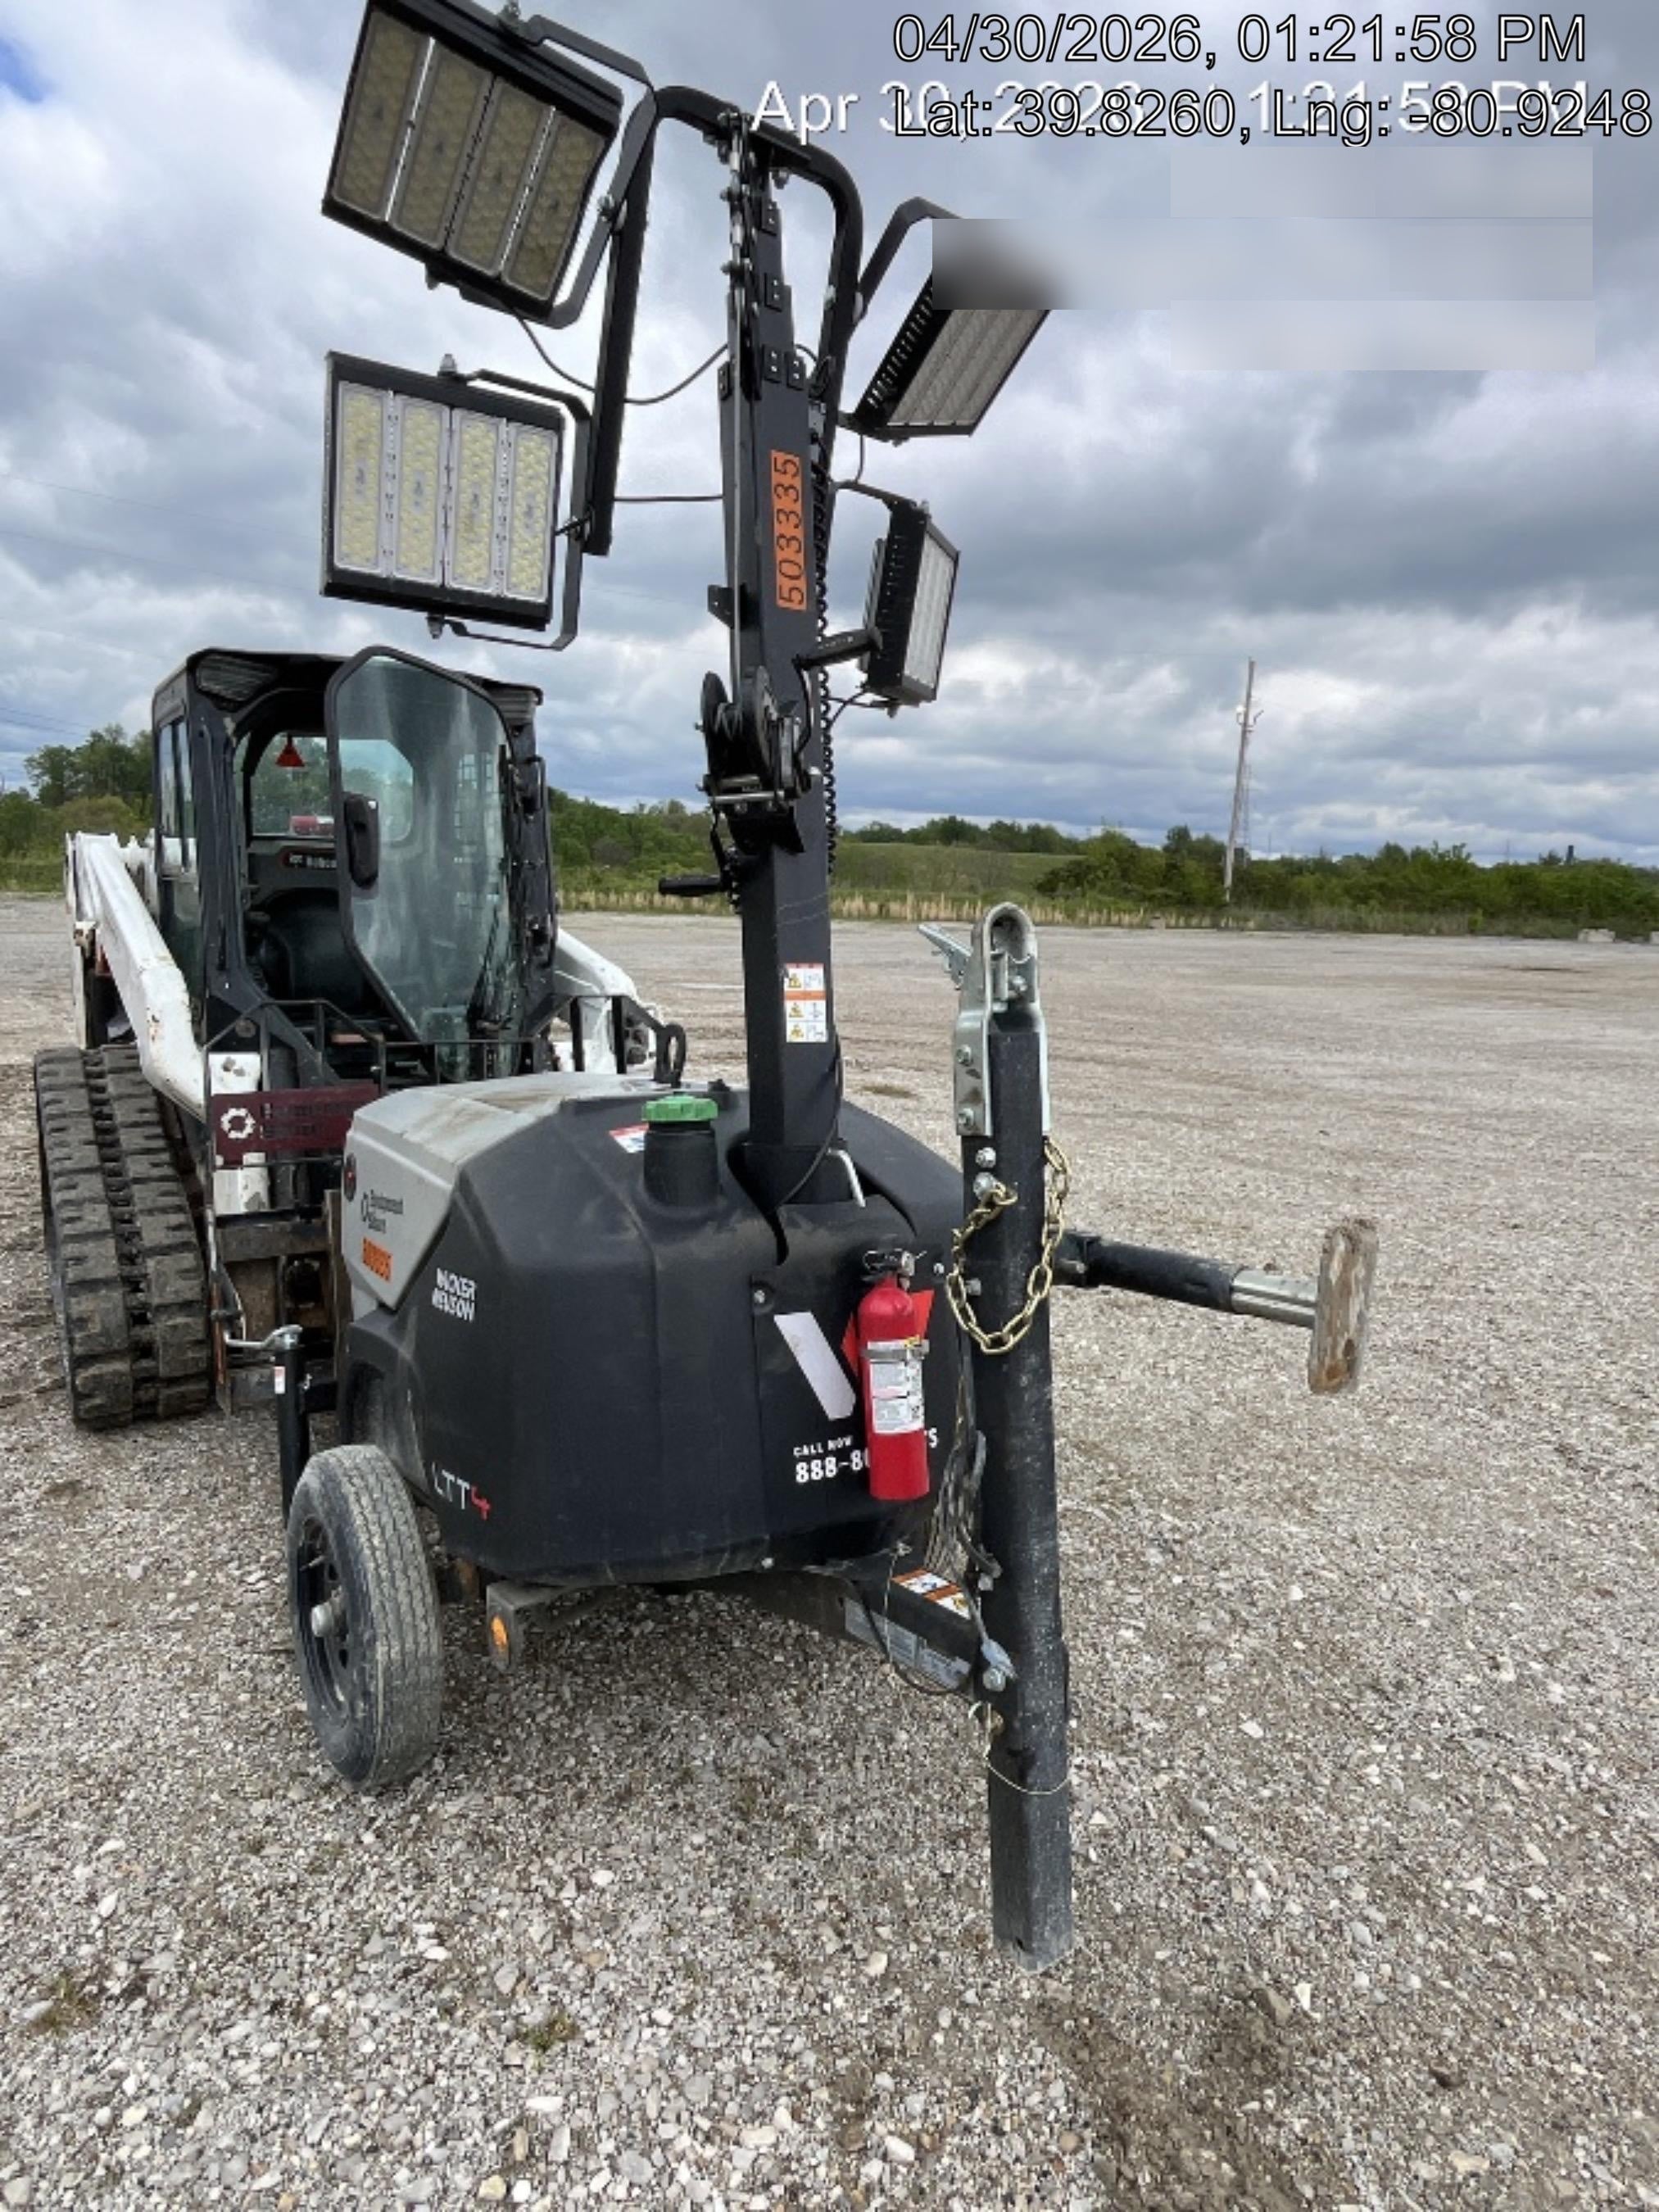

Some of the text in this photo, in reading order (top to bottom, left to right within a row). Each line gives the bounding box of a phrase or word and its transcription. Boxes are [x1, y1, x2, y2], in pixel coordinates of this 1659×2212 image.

[773, 456, 805, 605] 503335
[793, 1435, 853, 1457] CALL NOW
